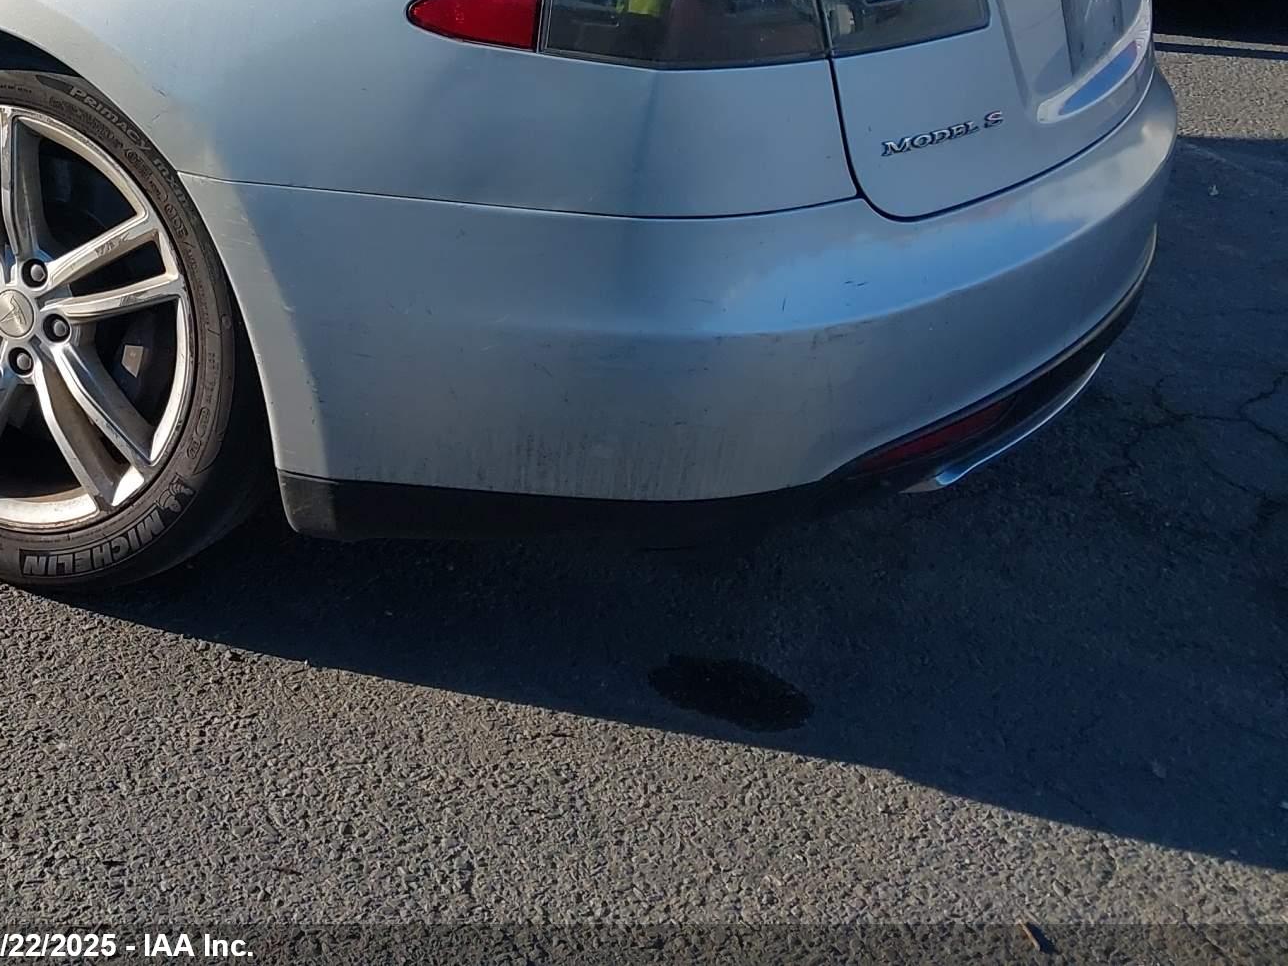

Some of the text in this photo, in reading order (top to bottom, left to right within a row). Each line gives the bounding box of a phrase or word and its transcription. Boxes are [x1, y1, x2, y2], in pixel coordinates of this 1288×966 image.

[68, 85, 151, 151] PRIMACY
[881, 109, 1004, 157] MODEL S
[23, 510, 164, 575] MICHELIN
